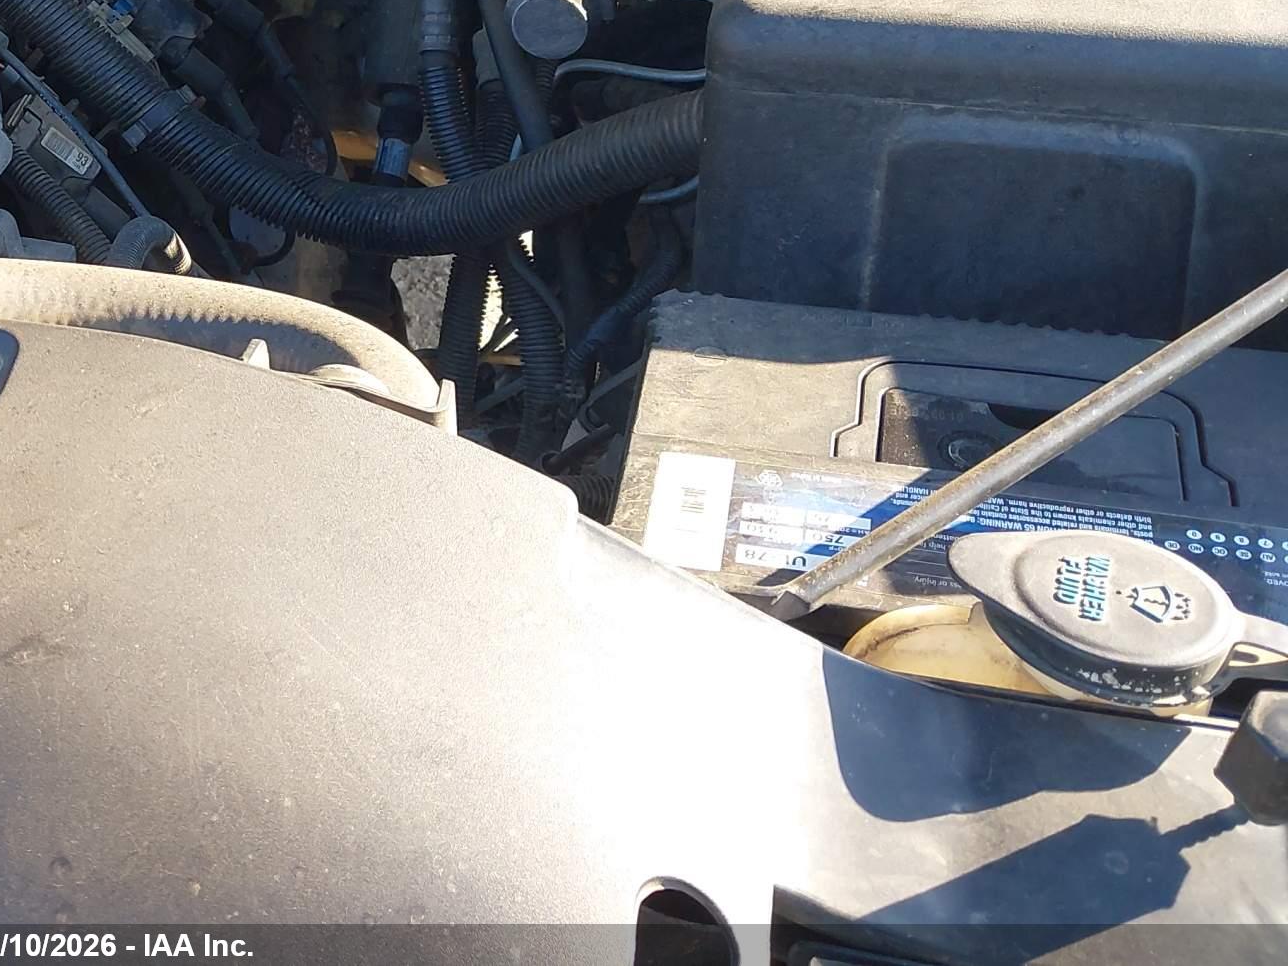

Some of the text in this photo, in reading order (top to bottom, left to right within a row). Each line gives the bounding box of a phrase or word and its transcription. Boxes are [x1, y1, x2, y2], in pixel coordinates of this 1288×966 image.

[76, 152, 89, 166] 93
[1006, 498, 1027, 507] harm.
[1029, 502, 1074, 513] reproductive
[981, 510, 1007, 521] contain
[1010, 506, 1029, 516] State
[1030, 509, 1042, 518] the
[1076, 508, 1095, 516] other
[1008, 514, 1051, 524] accessories
[1052, 512, 1076, 521] known
[1078, 515, 1116, 526] chemicals
[1106, 512, 1132, 521] defects
[1134, 516, 1152, 524] birth
[977, 517, 1023, 531] WARNING:
[1024, 523, 1035, 532] 65
[1051, 519, 1077, 528] related
[1117, 521, 1137, 529] other
[1138, 523, 1152, 531] and
[1094, 525, 1129, 536] terminals
[812, 532, 844, 545] 750
[928, 542, 946, 550] help
[913, 576, 936, 587] injury.
[1052, 556, 1082, 605] FLUID
[1078, 556, 1110, 622] WASHER
